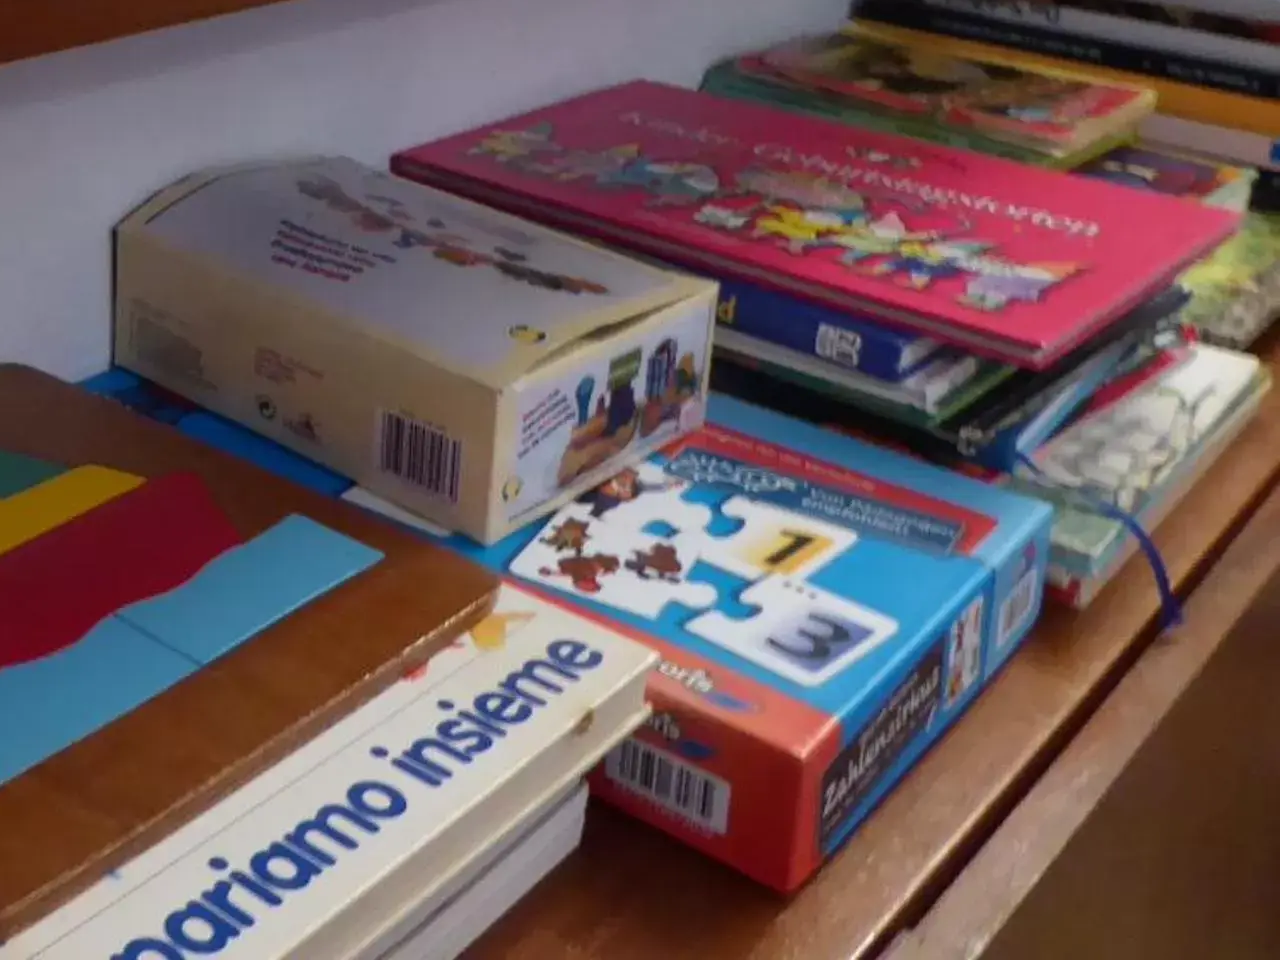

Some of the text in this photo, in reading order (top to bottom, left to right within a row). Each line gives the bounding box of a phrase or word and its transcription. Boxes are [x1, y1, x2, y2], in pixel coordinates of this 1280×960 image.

[764, 528, 818, 567] 1
[766, 612, 852, 660] 3
[370, 637, 605, 788] insieme
